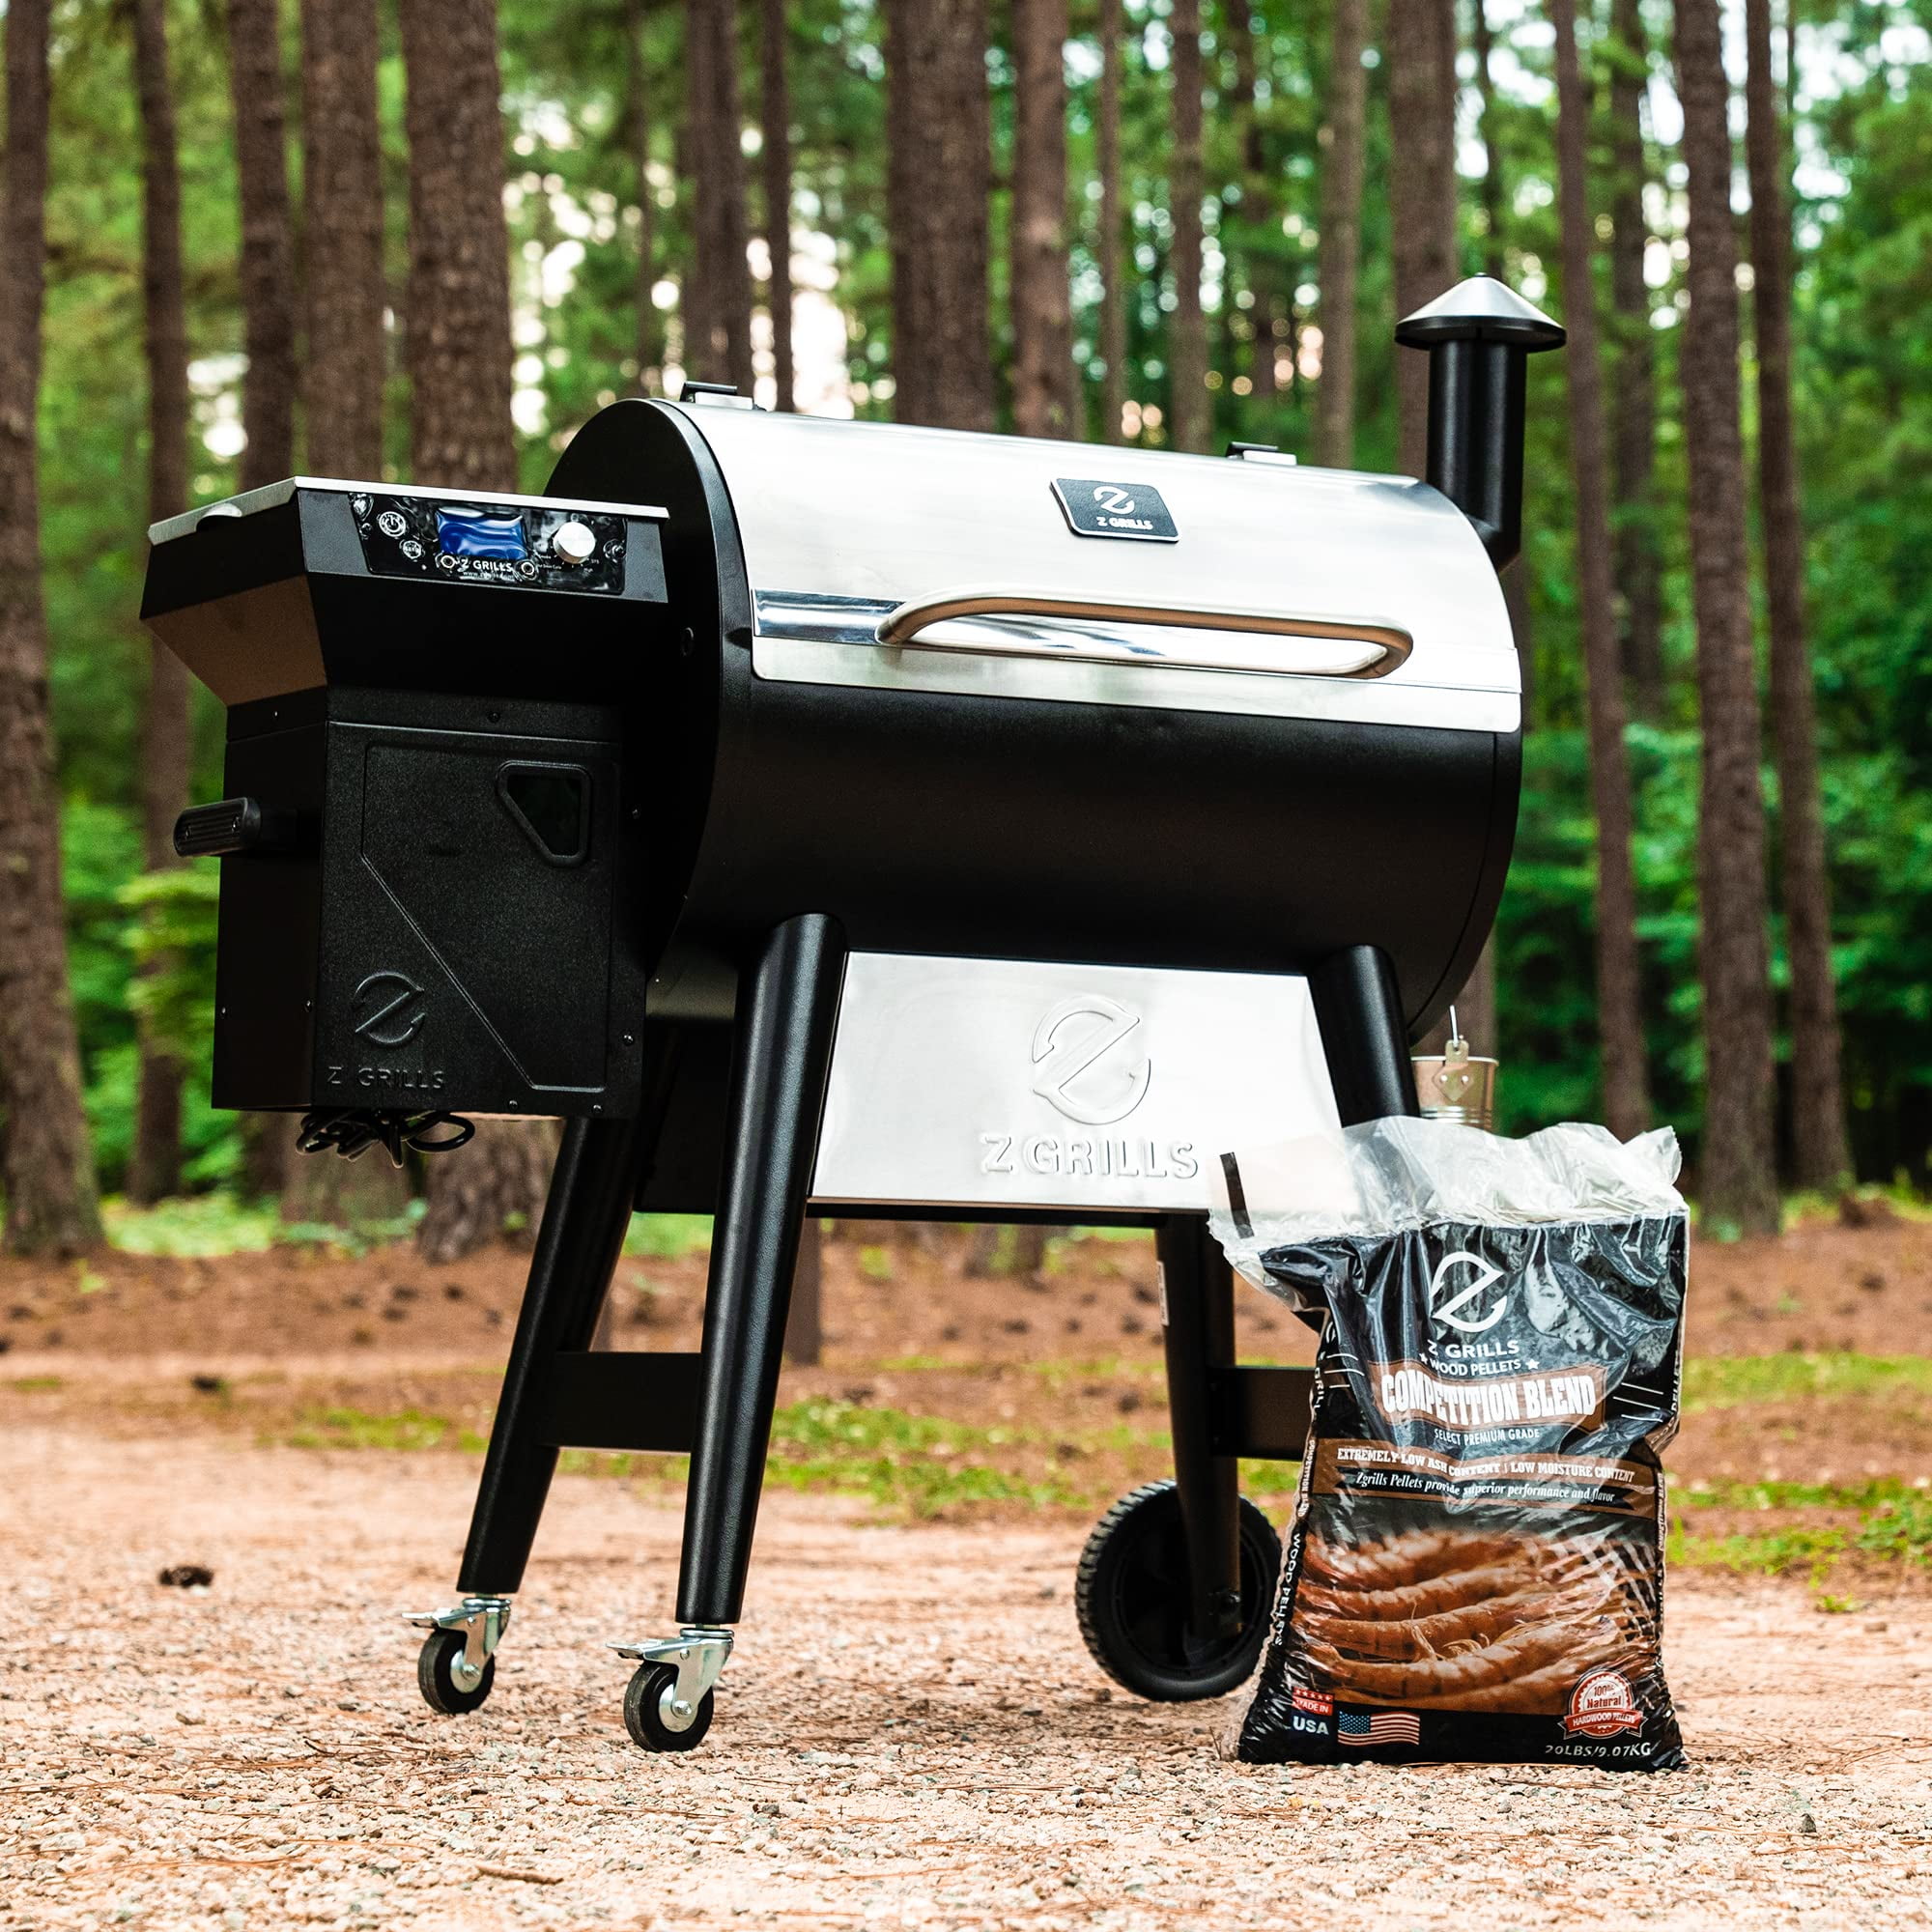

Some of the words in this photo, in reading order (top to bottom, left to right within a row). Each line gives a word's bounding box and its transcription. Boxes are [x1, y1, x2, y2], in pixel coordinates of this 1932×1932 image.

[1096, 516, 1107, 527] Z
[1109, 517, 1153, 530] GRILLS
[472, 560, 512, 572] GRILLS
[327, 1065, 343, 1084] Z
[357, 1067, 444, 1089] GRILLS
[980, 1134, 1013, 1174] Z
[1024, 1138, 1199, 1179] GRILLS
[1427, 1339, 1438, 1356] Z
[1445, 1339, 1520, 1359] GRILLS
[1430, 1357, 1468, 1377] WOOD
[1470, 1358, 1522, 1377] PELLETS
[1380, 1369, 1520, 1426] COMPETITION
[1522, 1375, 1597, 1420] BLEND
[1435, 1428, 1462, 1446] SELECT
[1463, 1430, 1507, 1446] PREMIUM
[1508, 1428, 1540, 1440] GRADE
[1337, 1447, 1398, 1463] EXTREMELY
[1401, 1453, 1427, 1466] LOW
[1427, 1458, 1448, 1473] ASH
[1448, 1463, 1500, 1478] CONTENT
[1510, 1462, 1536, 1474] LOW
[1537, 1462, 1593, 1478] MOISTURE
[1594, 1465, 1635, 1483] CONTENT
[1356, 1471, 1388, 1488] Zgrills
[1390, 1474, 1423, 1489] Pellets
[1424, 1479, 1461, 1495] provide
[1463, 1482, 1506, 1498] superior
[1507, 1483, 1570, 1501] performance
[1571, 1488, 1590, 1500] and
[1591, 1489, 1615, 1503] flavor
[1286, 1533, 1301, 1584] WOOD
[1320, 1705, 1329, 1714] IN
[1586, 1695, 1622, 1709] Natural
[1293, 1716, 1329, 1736] USA
[1573, 1712, 1612, 1727] HARDWOOD
